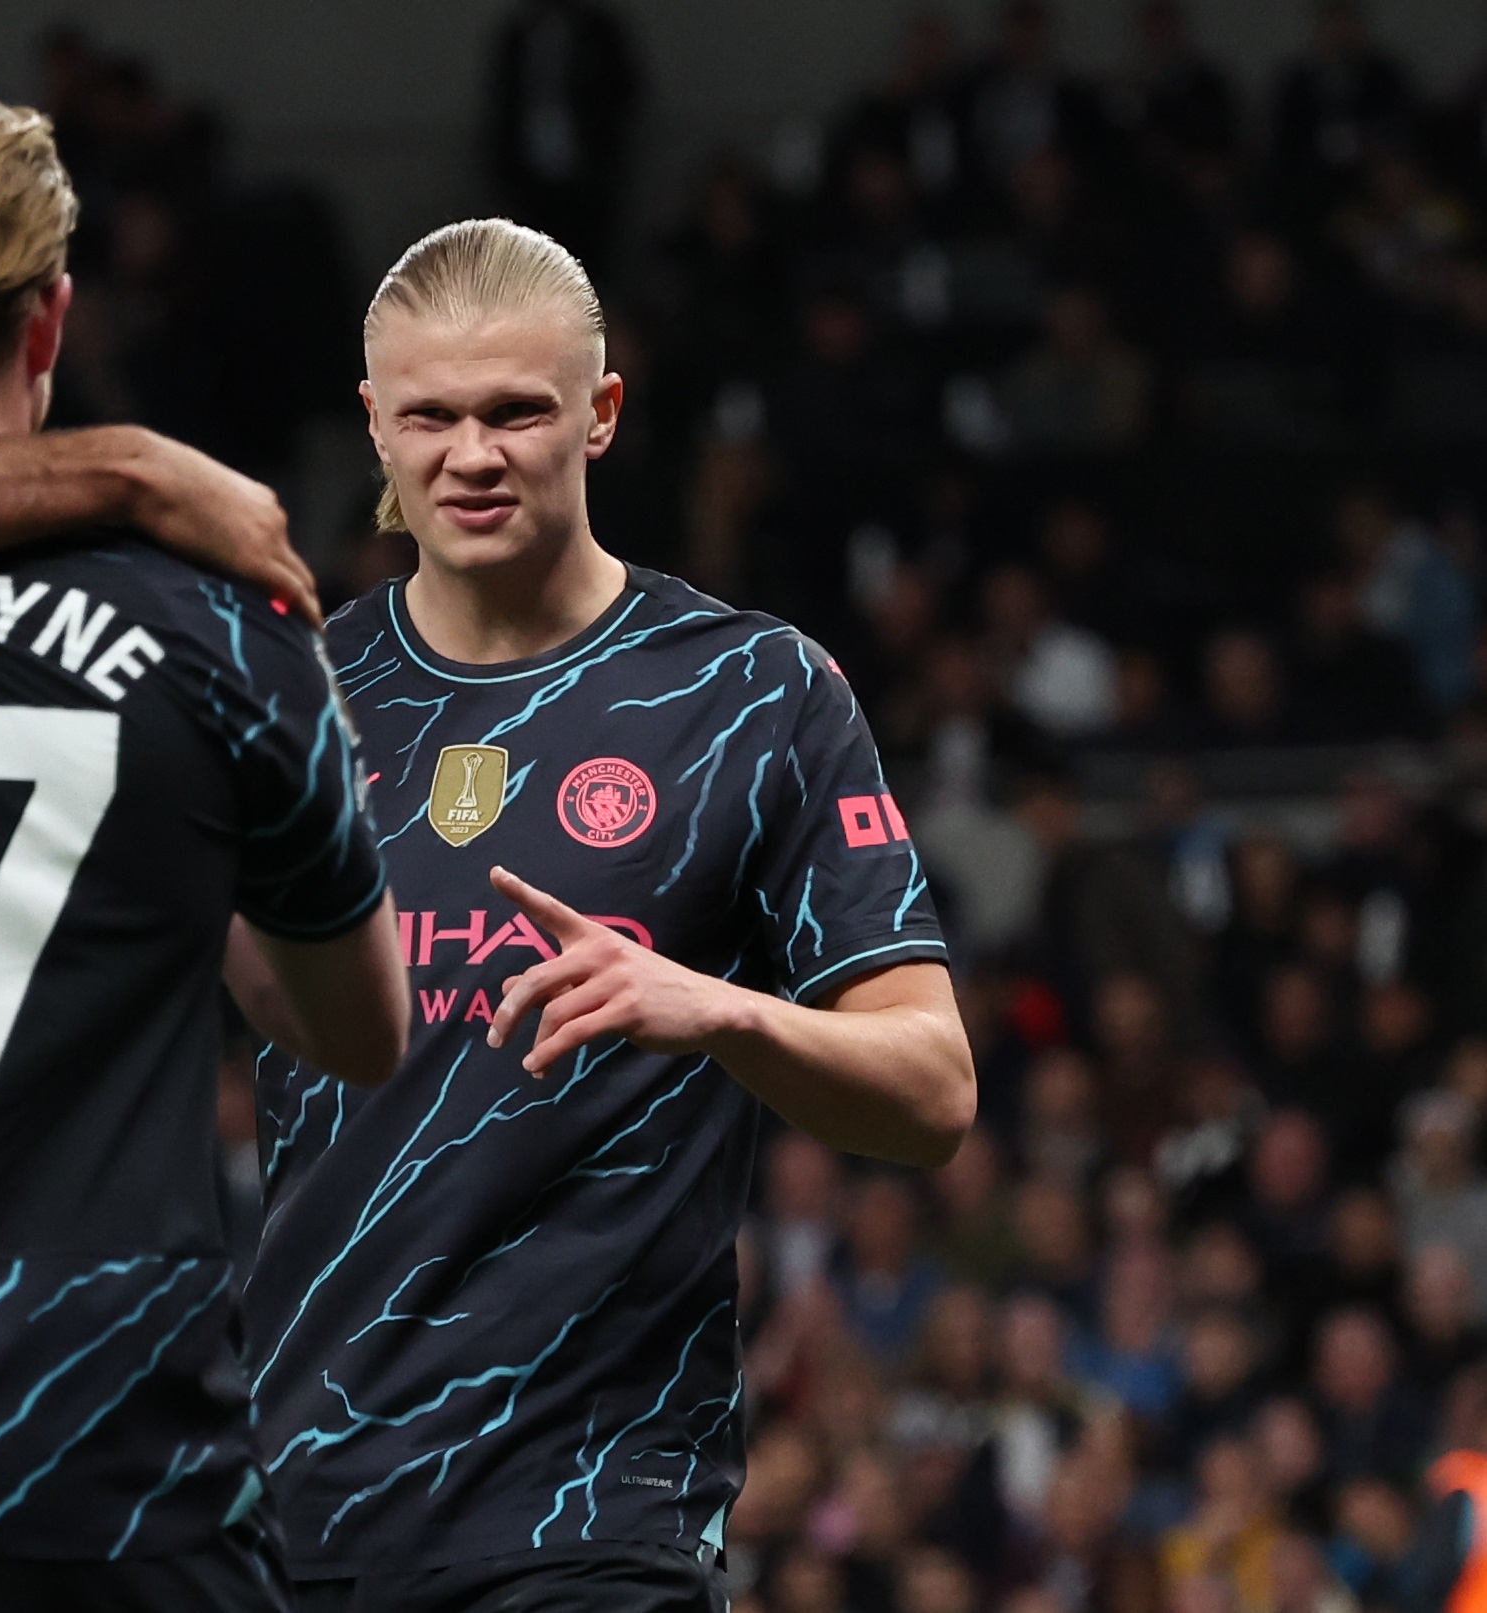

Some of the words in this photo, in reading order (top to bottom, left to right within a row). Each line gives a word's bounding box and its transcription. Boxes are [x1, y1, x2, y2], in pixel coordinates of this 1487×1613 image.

[571, 764, 646, 797] MANCHESTER
[446, 809, 480, 821] FIFA
[587, 829, 616, 840] CITY
